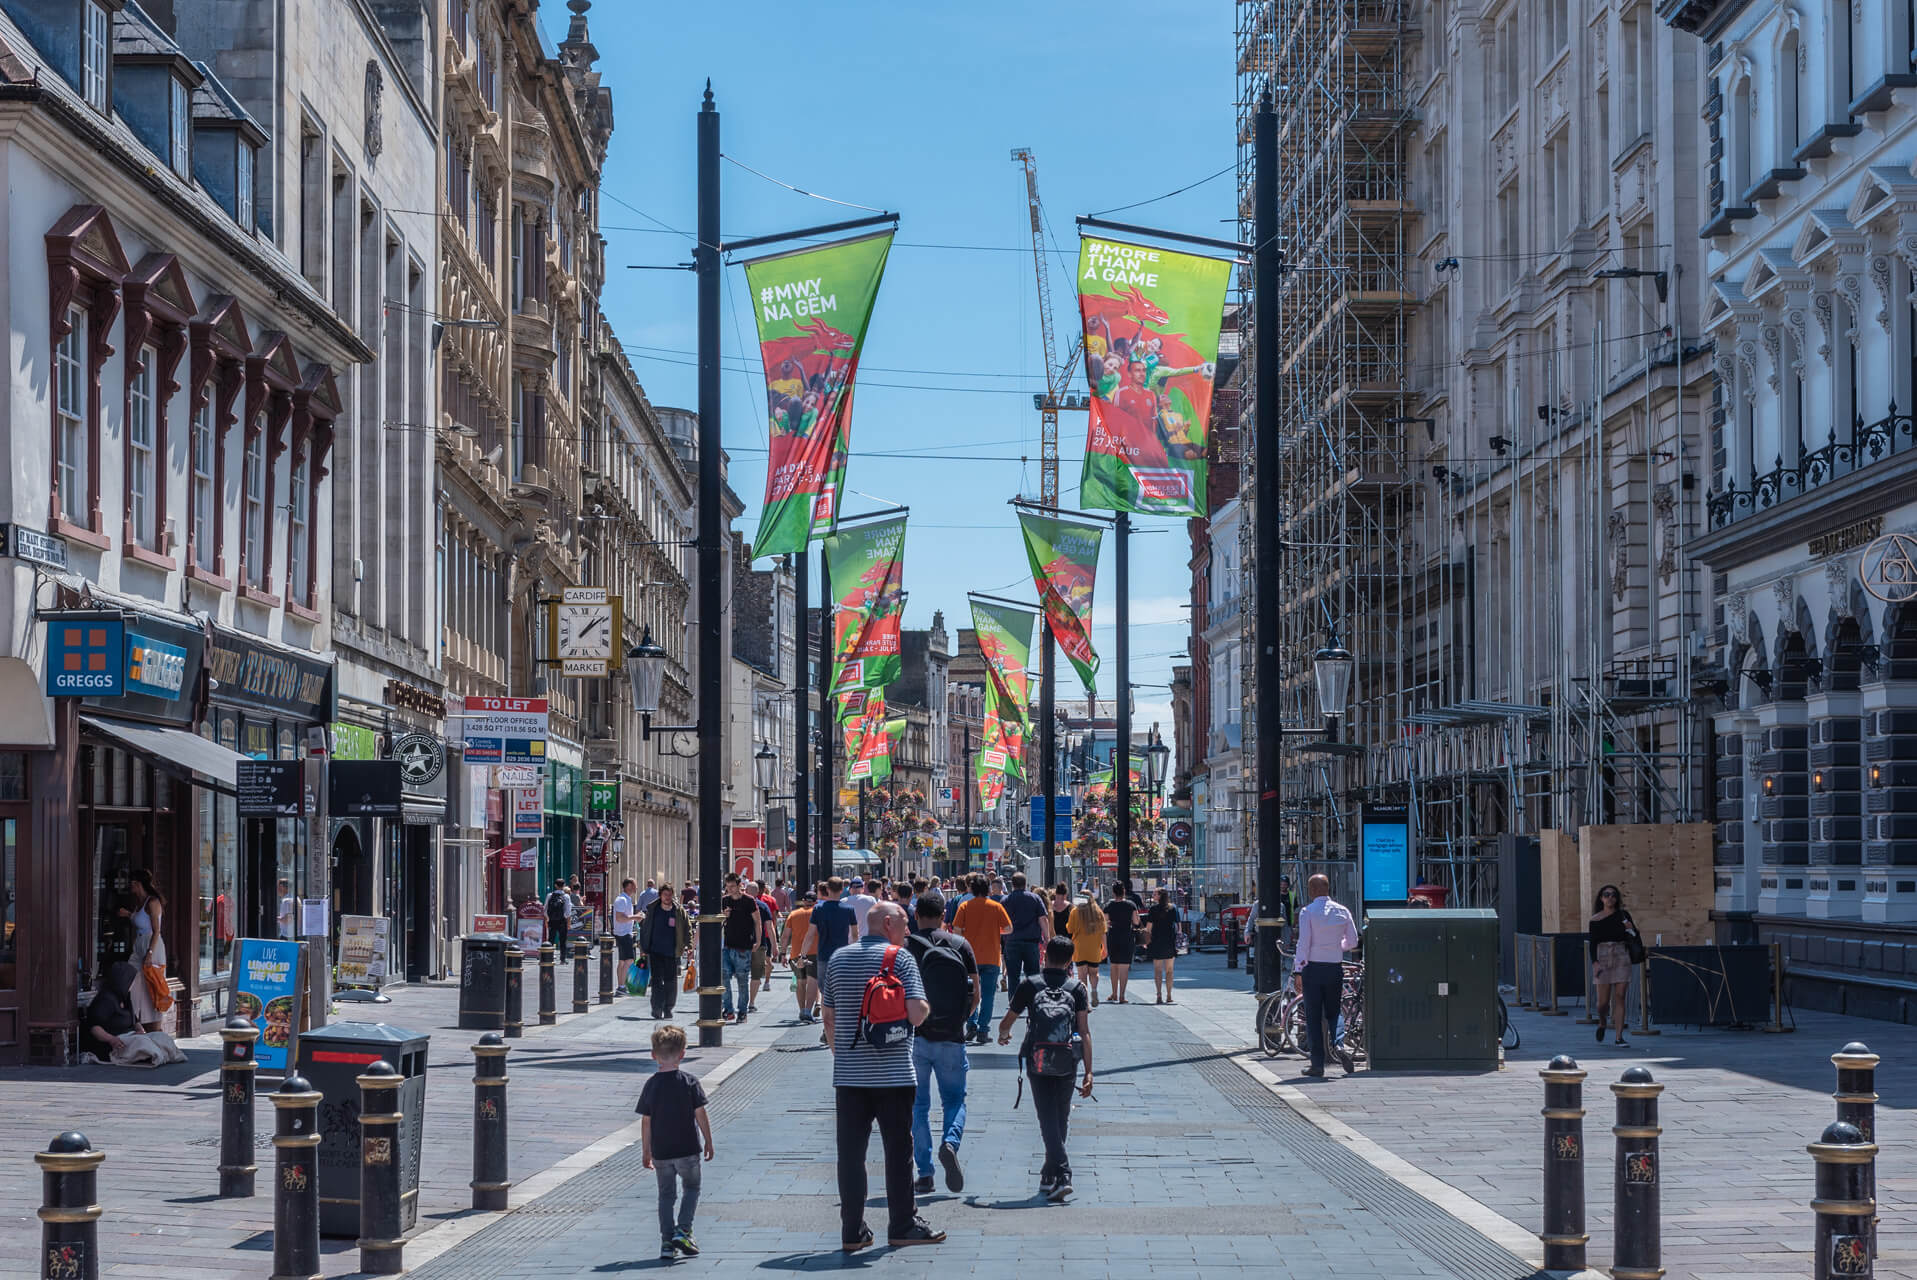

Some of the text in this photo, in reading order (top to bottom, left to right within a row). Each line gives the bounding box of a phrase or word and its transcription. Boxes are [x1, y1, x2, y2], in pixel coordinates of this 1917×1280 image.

[1088, 243, 1160, 262] #MORE
[1087, 254, 1141, 272] THAN
[1083, 266, 1160, 288] A GAME
[760, 277, 822, 305] #MWY
[763, 293, 837, 323] NA GÊM
[564, 591, 606, 600] CARDIFF
[564, 663, 605, 672] MARKET
[56, 674, 113, 688] GREGGS
[243, 650, 298, 700] TATTOO
[483, 699, 531, 711] TO LET
[511, 717, 538, 725] OFFICES
[484, 724, 494, 732] SQ
[502, 772, 534, 781] NAILS
[522, 790, 537, 798] TO
[593, 790, 612, 804] PP
[518, 801, 540, 810] LET
[262, 947, 278, 960] LIVE
[247, 960, 275, 972] LUNCH
[248, 970, 265, 981] THE
